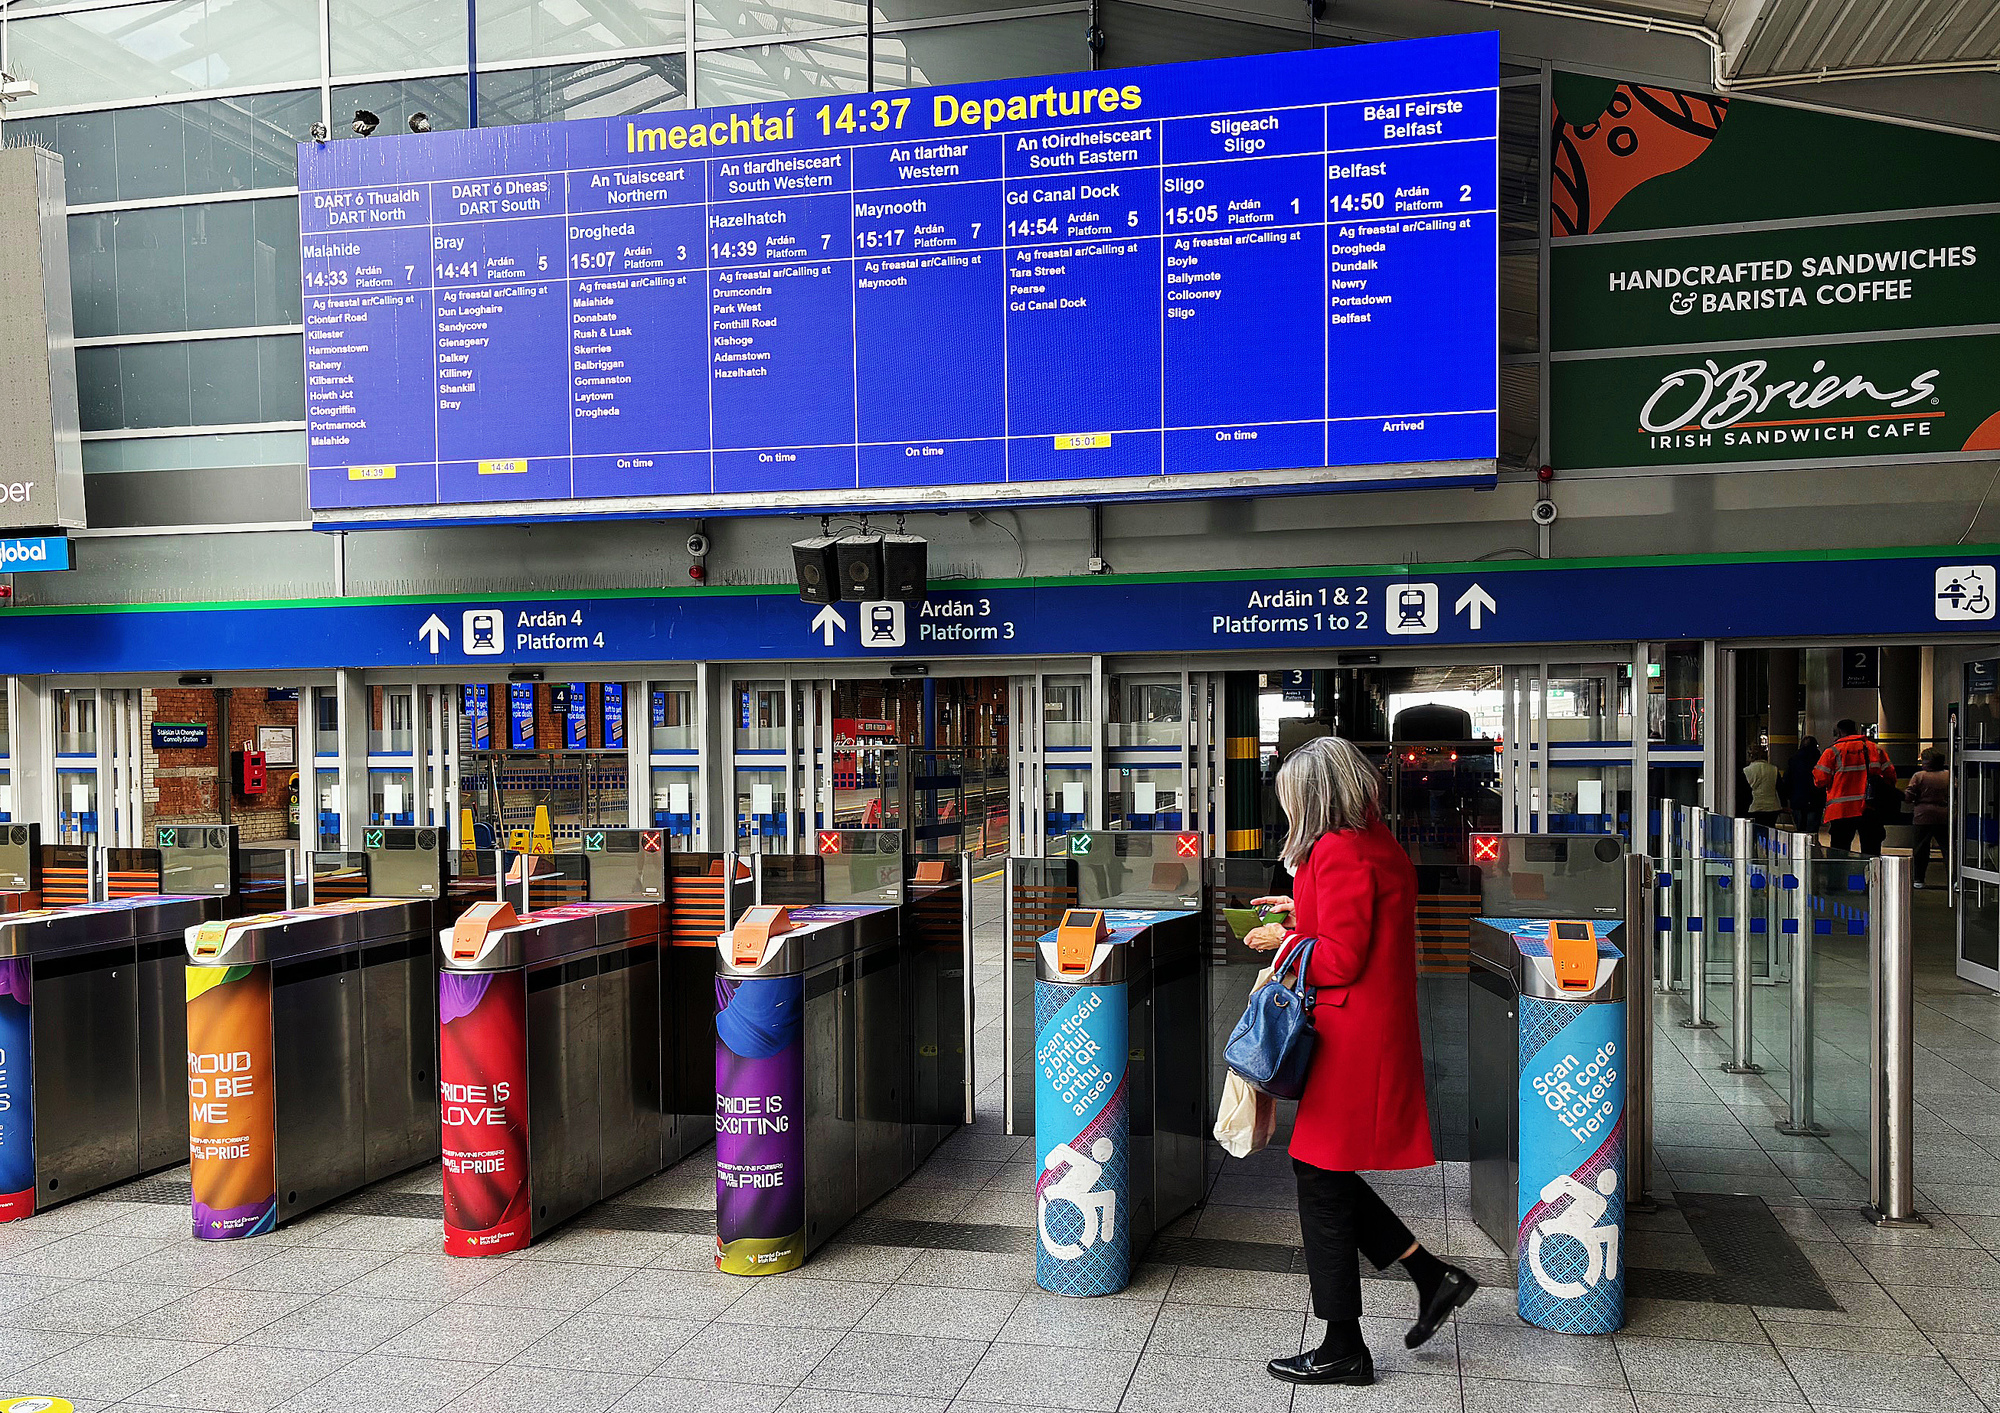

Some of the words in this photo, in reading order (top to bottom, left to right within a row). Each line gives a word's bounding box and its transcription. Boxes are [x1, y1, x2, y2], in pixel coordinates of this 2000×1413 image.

[627, 105, 794, 153] Imeachtaí
[816, 100, 911, 136] 14:37
[933, 86, 1141, 128] Departures
[1364, 105, 1400, 121] Béal
[1405, 101, 1463, 117] Feirste
[1210, 116, 1279, 135] Sligeach
[1384, 121, 1442, 139] Belfast
[1017, 137, 1038, 151] An
[1042, 127, 1151, 148] tOirdheisceart
[1224, 137, 1265, 154] Sligo
[890, 149, 910, 162] An
[1029, 154, 1075, 168] South
[1078, 149, 1137, 165] Eastern
[591, 174, 610, 187] An
[614, 169, 684, 185] Tuaisceart
[720, 163, 739, 176] An
[899, 164, 959, 179] Western
[1329, 162, 1386, 179] Belfast
[452, 183, 490, 198] DART
[493, 183, 501, 194] ó
[506, 181, 548, 194] Dheas
[729, 180, 770, 193] South
[774, 174, 832, 190] Western
[1164, 178, 1204, 193] Sligo
[1395, 186, 1429, 197] Ardán
[315, 195, 351, 209] DART
[355, 195, 363, 205] ó
[367, 190, 419, 205] Thuaidh
[607, 189, 667, 203] Northern
[1007, 191, 1028, 205] Gd
[1032, 188, 1076, 202] Canal
[1080, 183, 1120, 198] Dock
[1459, 185, 1471, 201] 2
[459, 201, 498, 215] DART
[501, 199, 540, 212] South
[855, 199, 926, 217] Maynooth
[1330, 192, 1384, 213] 14:50
[1395, 200, 1442, 211] Platform
[329, 211, 366, 225] DART
[370, 209, 405, 222] North
[709, 211, 786, 228] Hazelhatch
[1165, 205, 1218, 225] 15:05
[569, 224, 635, 240] Drogheda
[1008, 218, 1058, 237] 14:54
[1339, 226, 1354, 237] Ag
[1358, 223, 1399, 235] freastal
[1402, 220, 1456, 233] ar/Calling
[1459, 218, 1471, 228] at
[434, 237, 464, 251] Bray
[857, 229, 904, 248] 15:17
[304, 244, 360, 258] Malahide
[711, 241, 757, 258] 14:39
[1332, 243, 1385, 255] Drogheda
[571, 251, 614, 269] 15:07
[1332, 259, 1378, 272] Dundalk
[1609, 260, 1792, 291] HANDCRAFTED
[1801, 245, 1977, 277] SANDWICHES
[436, 261, 478, 279] 14:41
[305, 271, 348, 287] 14:33
[1332, 278, 1367, 290] Newry
[713, 286, 772, 297] Drumcondra
[1167, 289, 1221, 301] Collooney
[1332, 294, 1391, 306] Portadown
[1669, 292, 1697, 316] &
[1702, 288, 1807, 313] BARISTA
[1816, 279, 1912, 304] COFFEE
[308, 314, 342, 324] Clontarf
[344, 312, 367, 322] Road
[574, 360, 624, 370] Balbriggan
[714, 351, 770, 362] Adamstown
[440, 369, 472, 380] Killiney
[1639, 360, 1940, 433] O'Briens
[311, 420, 366, 430] Portmarnock
[1383, 421, 1424, 432] Arrived
[1069, 437, 1095, 446] 15:01
[1215, 431, 1231, 441] On
[1234, 430, 1257, 440] time
[1651, 434, 1711, 449] IRISH
[1724, 427, 1855, 446] SANDWICH
[1867, 422, 1931, 437] CAFE
[759, 454, 773, 462] On
[776, 452, 796, 461] time
[905, 447, 919, 456] On
[922, 446, 944, 456] time
[492, 463, 514, 471] 14:46
[617, 459, 630, 468] On
[634, 459, 653, 467] time
[0, 540, 46, 569] lobal
[1248, 589, 1313, 609] Ardáin
[1319, 589, 1326, 606] 1
[1333, 588, 1350, 605] &
[1355, 587, 1368, 605] 2
[920, 600, 973, 617] Ardán
[979, 599, 990, 616] 3
[517, 610, 566, 628] Ardán
[572, 610, 582, 626] 4
[1213, 615, 1308, 635] Platforms
[1313, 614, 1323, 630] 1
[1328, 615, 1349, 630] to
[1355, 612, 1368, 629] 2
[920, 624, 997, 640] Platform
[1003, 622, 1015, 639] 3
[517, 631, 589, 650] Platform
[593, 632, 605, 648] 4
[1855, 653, 1866, 667] 2
[1292, 670, 1302, 684] 3
[557, 691, 564, 701] 4
[1038, 1033, 1065, 1065] Scan
[1061, 992, 1102, 1035] ticéid
[1044, 1066, 1053, 1079] a
[1049, 1028, 1091, 1069] bhfuil
[1052, 1061, 1078, 1091] cód
[1075, 1040, 1101, 1065] QR
[1062, 1064, 1100, 1103] orthu
[1532, 1054, 1580, 1096] Scan
[1545, 1082, 1578, 1111] QR
[1575, 1041, 1616, 1086] code
[215, 1075, 253, 1098] BE
[493, 1082, 509, 1103] IS
[1073, 1071, 1112, 1116] anseo
[717, 1093, 761, 1114] PRIDE
[766, 1096, 782, 1113] IS
[1558, 1067, 1617, 1127] tickets
[193, 1102, 228, 1123] ME
[716, 1113, 788, 1134] EXCITING
[1571, 1100, 1613, 1143] here
[206, 1144, 250, 1160] PRIDE
[461, 1158, 505, 1173] PRIDE
[740, 1172, 783, 1188] PRIDE
